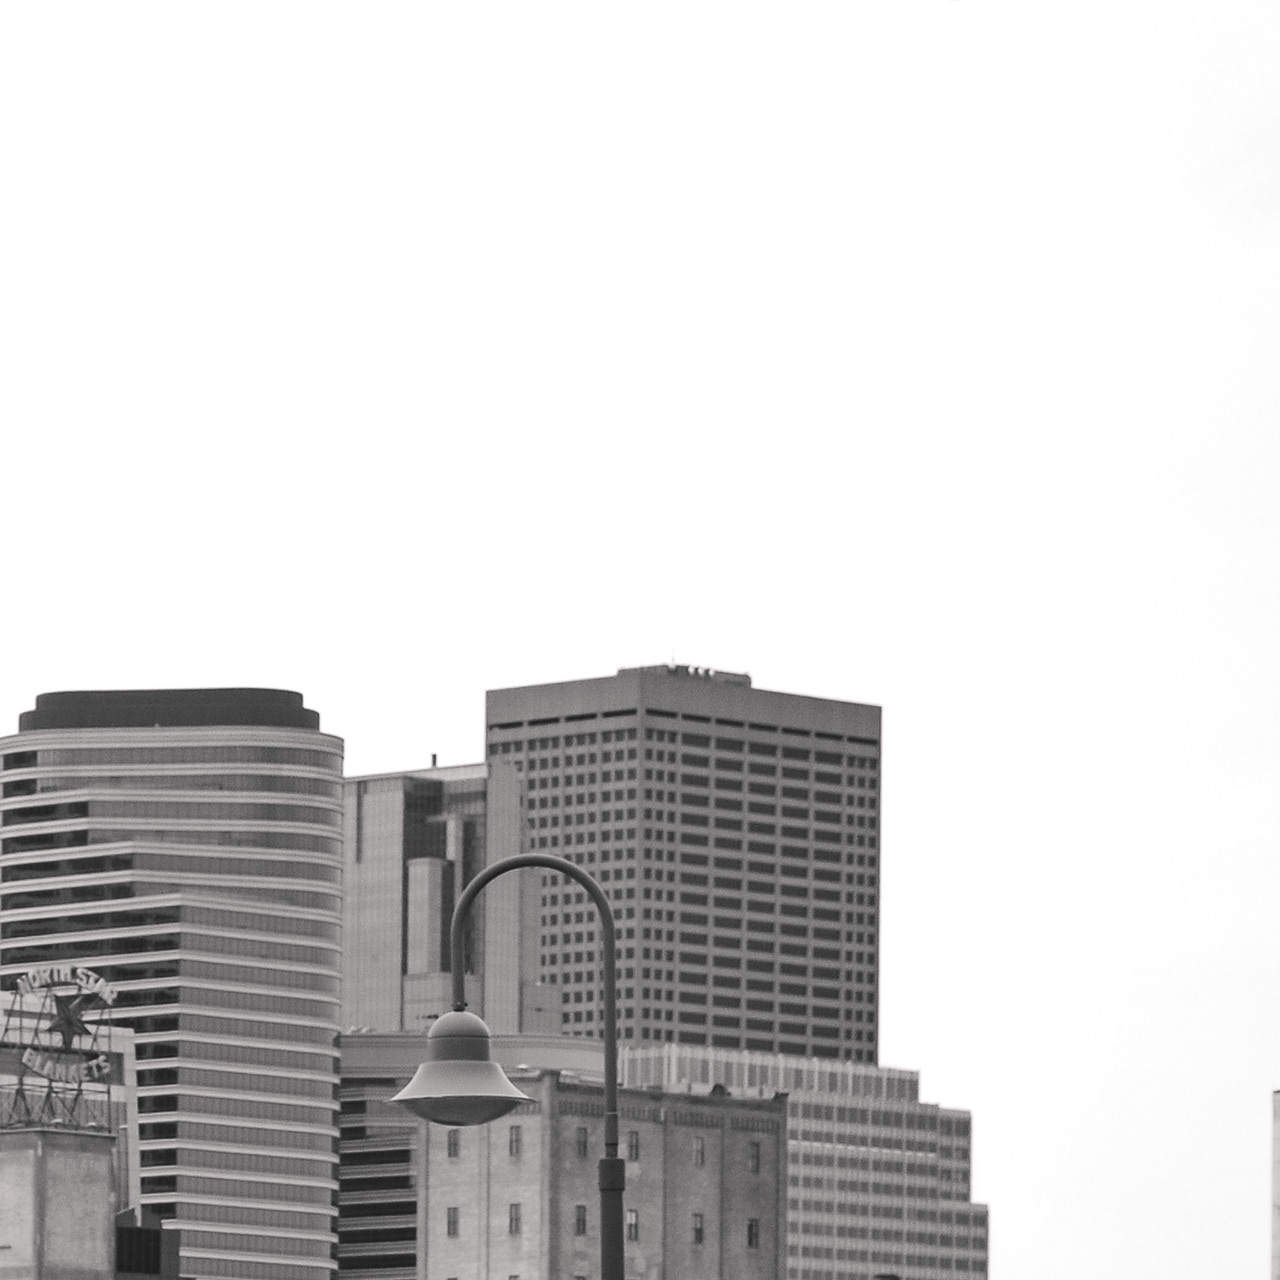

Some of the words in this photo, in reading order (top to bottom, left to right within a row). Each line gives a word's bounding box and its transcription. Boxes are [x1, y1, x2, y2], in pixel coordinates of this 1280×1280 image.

[17, 966, 72, 995] NORTH
[76, 968, 118, 1006] STAR
[22, 1048, 110, 1083] BLANKETS
